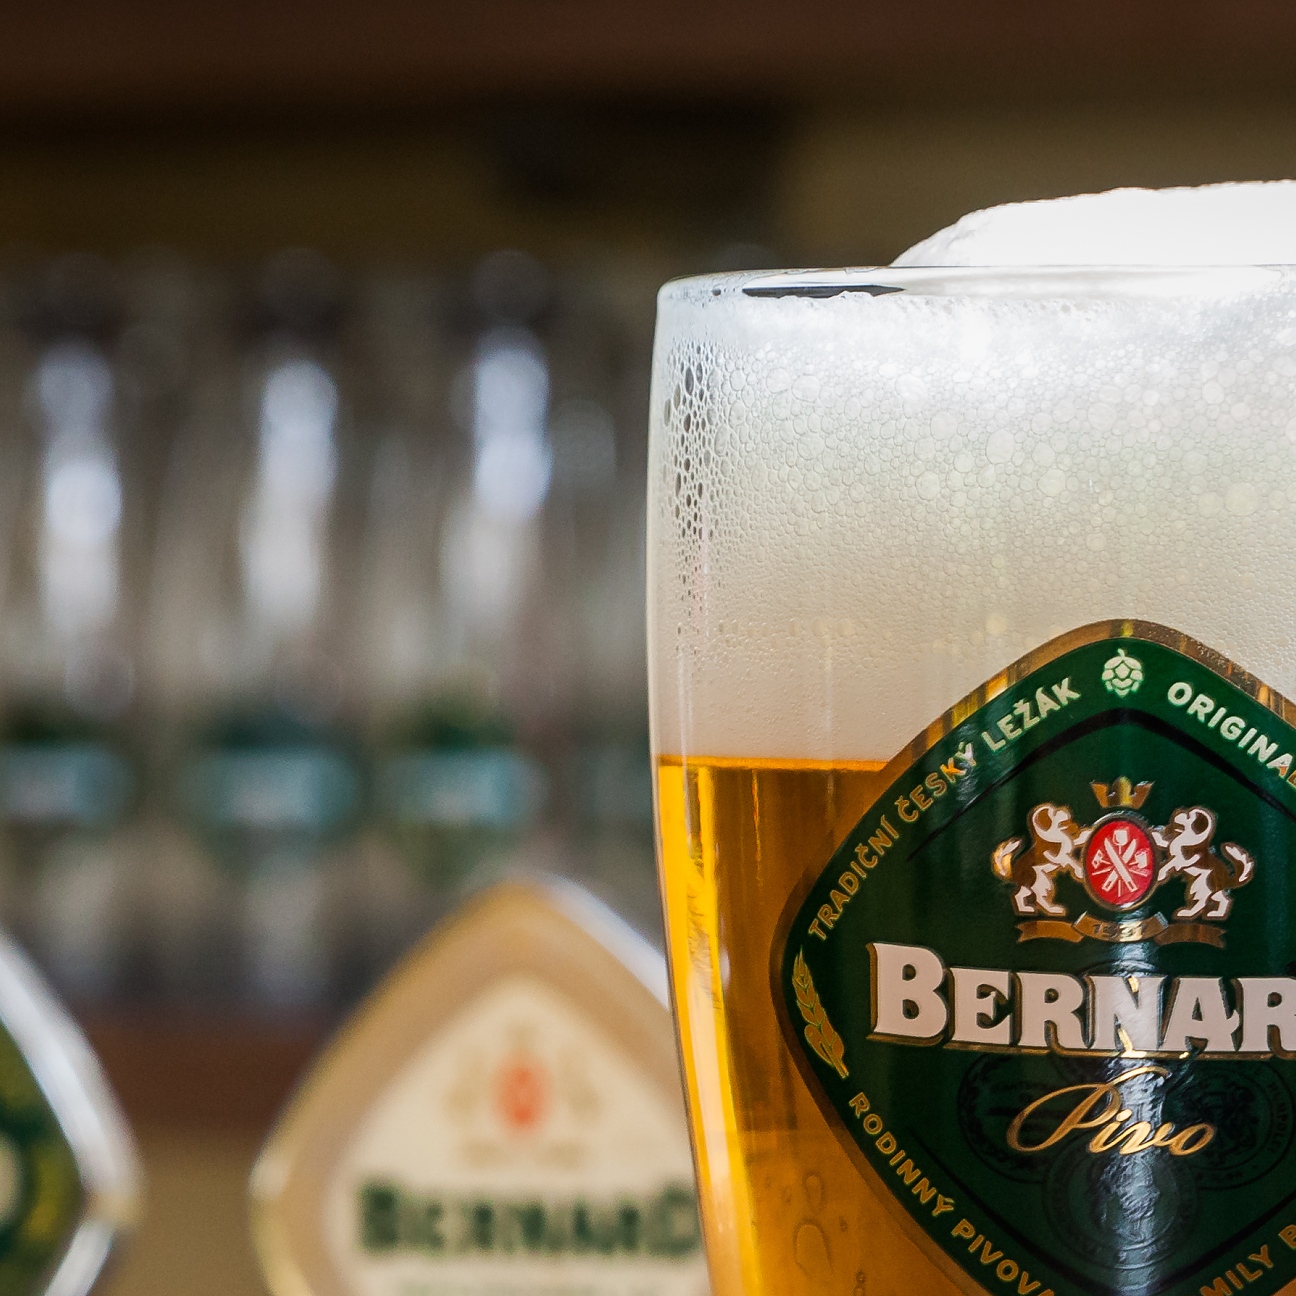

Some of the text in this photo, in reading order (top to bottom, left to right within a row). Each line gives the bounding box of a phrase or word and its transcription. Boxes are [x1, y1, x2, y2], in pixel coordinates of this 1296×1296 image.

[807, 677, 1082, 941] TRADIČNÍ ČESKÝ LEŽÁK
[848, 1091, 955, 1217] RODINNÝ
[1006, 1065, 1219, 1157] Pivo
